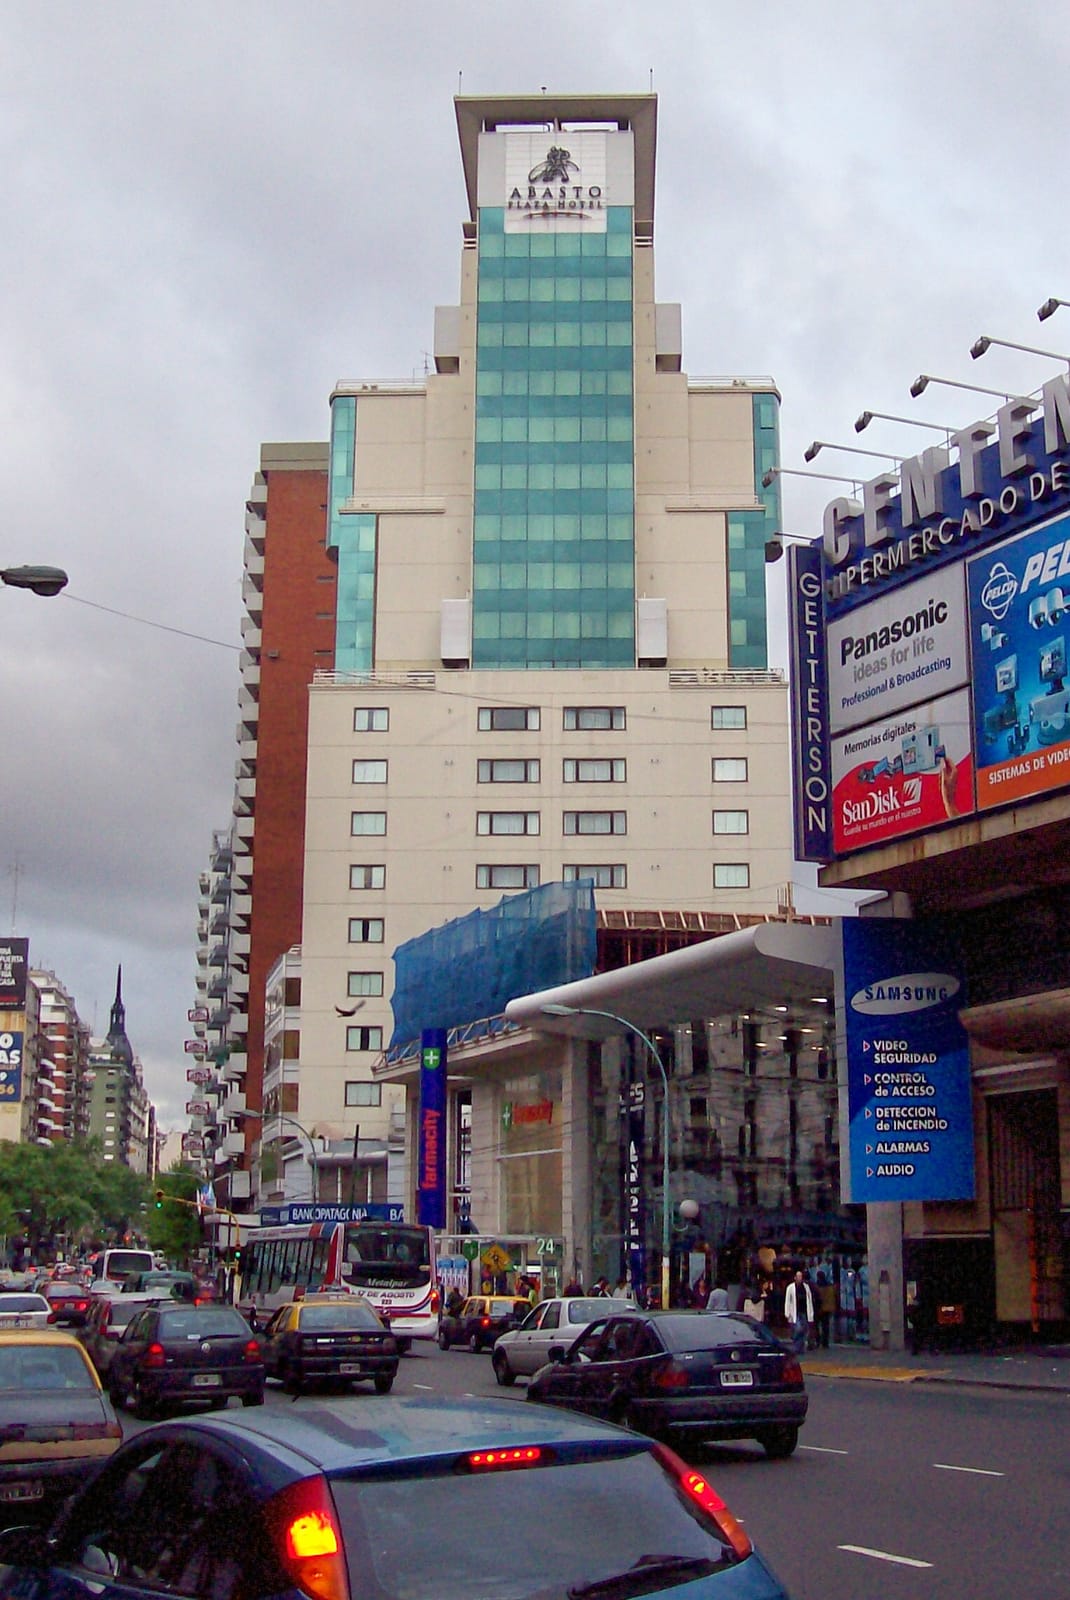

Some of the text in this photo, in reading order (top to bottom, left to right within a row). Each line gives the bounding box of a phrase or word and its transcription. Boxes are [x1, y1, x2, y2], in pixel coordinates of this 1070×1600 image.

[510, 185, 602, 200] ABASTO
[508, 201, 603, 210] PLAZA HOTEL
[985, 579, 1017, 603] PELCO
[841, 598, 948, 667] Panasonic
[853, 635, 935, 684] ideas for life
[841, 657, 951, 709] Professional & Broadcasting
[799, 572, 828, 833] GETTERSON
[844, 722, 916, 756] Memorias digitales
[988, 748, 1070, 785] SISTEMAS DE VIDE
[842, 785, 901, 826] SanDisk
[864, 986, 948, 1001] SAMSUNG
[873, 1040, 908, 1052] VIDEO
[874, 1053, 937, 1065] SEGURIDAD
[874, 1073, 927, 1085] CONTROL
[874, 1085, 935, 1097] de ACCESO
[876, 1106, 936, 1119] DETECCION
[876, 1119, 948, 1132] de INCENDIO
[421, 1108, 441, 1190] farmacity
[876, 1142, 930, 1154] ALARMAS
[876, 1164, 915, 1176] AUDIO
[536, 1238, 555, 1255] 24
